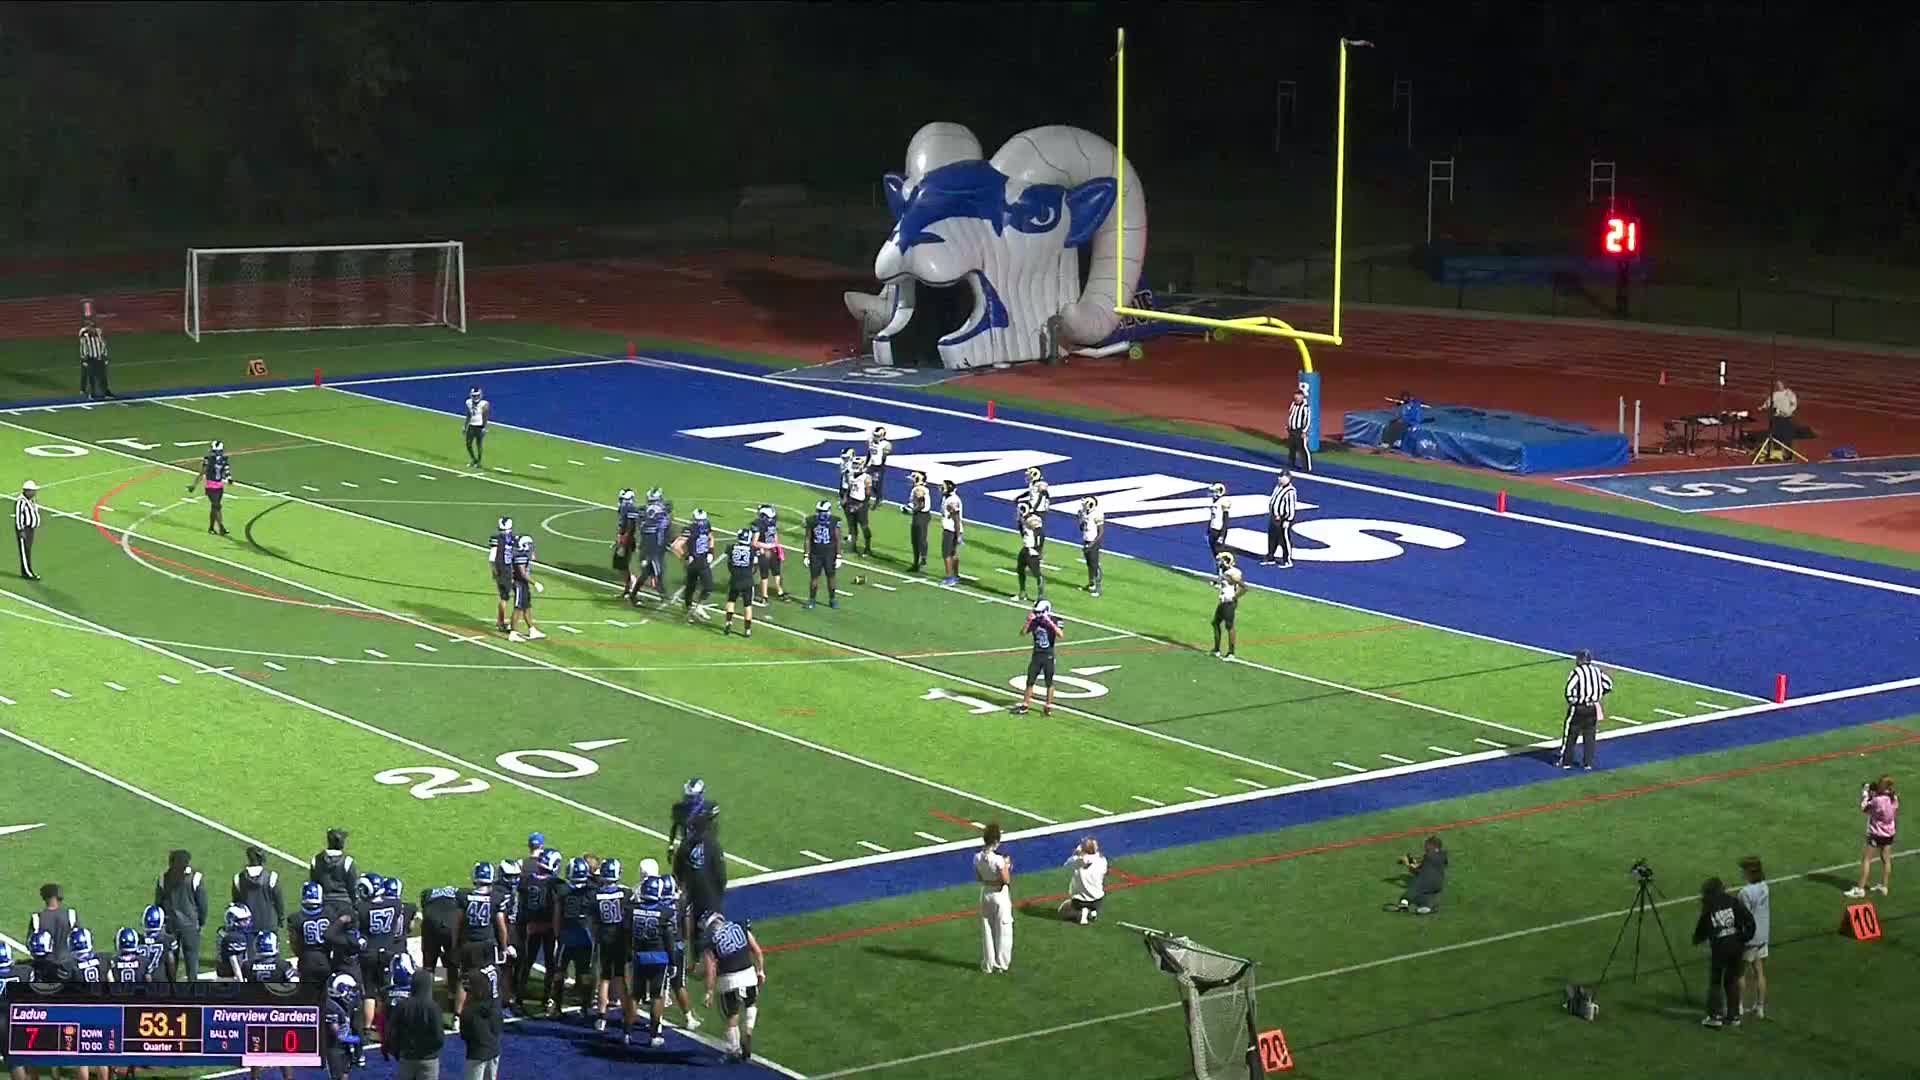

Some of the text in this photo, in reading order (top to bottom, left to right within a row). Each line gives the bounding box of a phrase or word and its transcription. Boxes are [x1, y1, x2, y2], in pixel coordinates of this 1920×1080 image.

[1606, 219, 1636, 253] 21
[254, 362, 266, 374] G
[675, 415, 1466, 562] RAMS
[374, 749, 599, 799] 20
[369, 907, 396, 934] 57
[466, 901, 492, 928] 44
[599, 899, 623, 923] 81
[1854, 906, 1876, 937] 10
[713, 922, 749, 955] 20
[1260, 1034, 1288, 1069] 20
